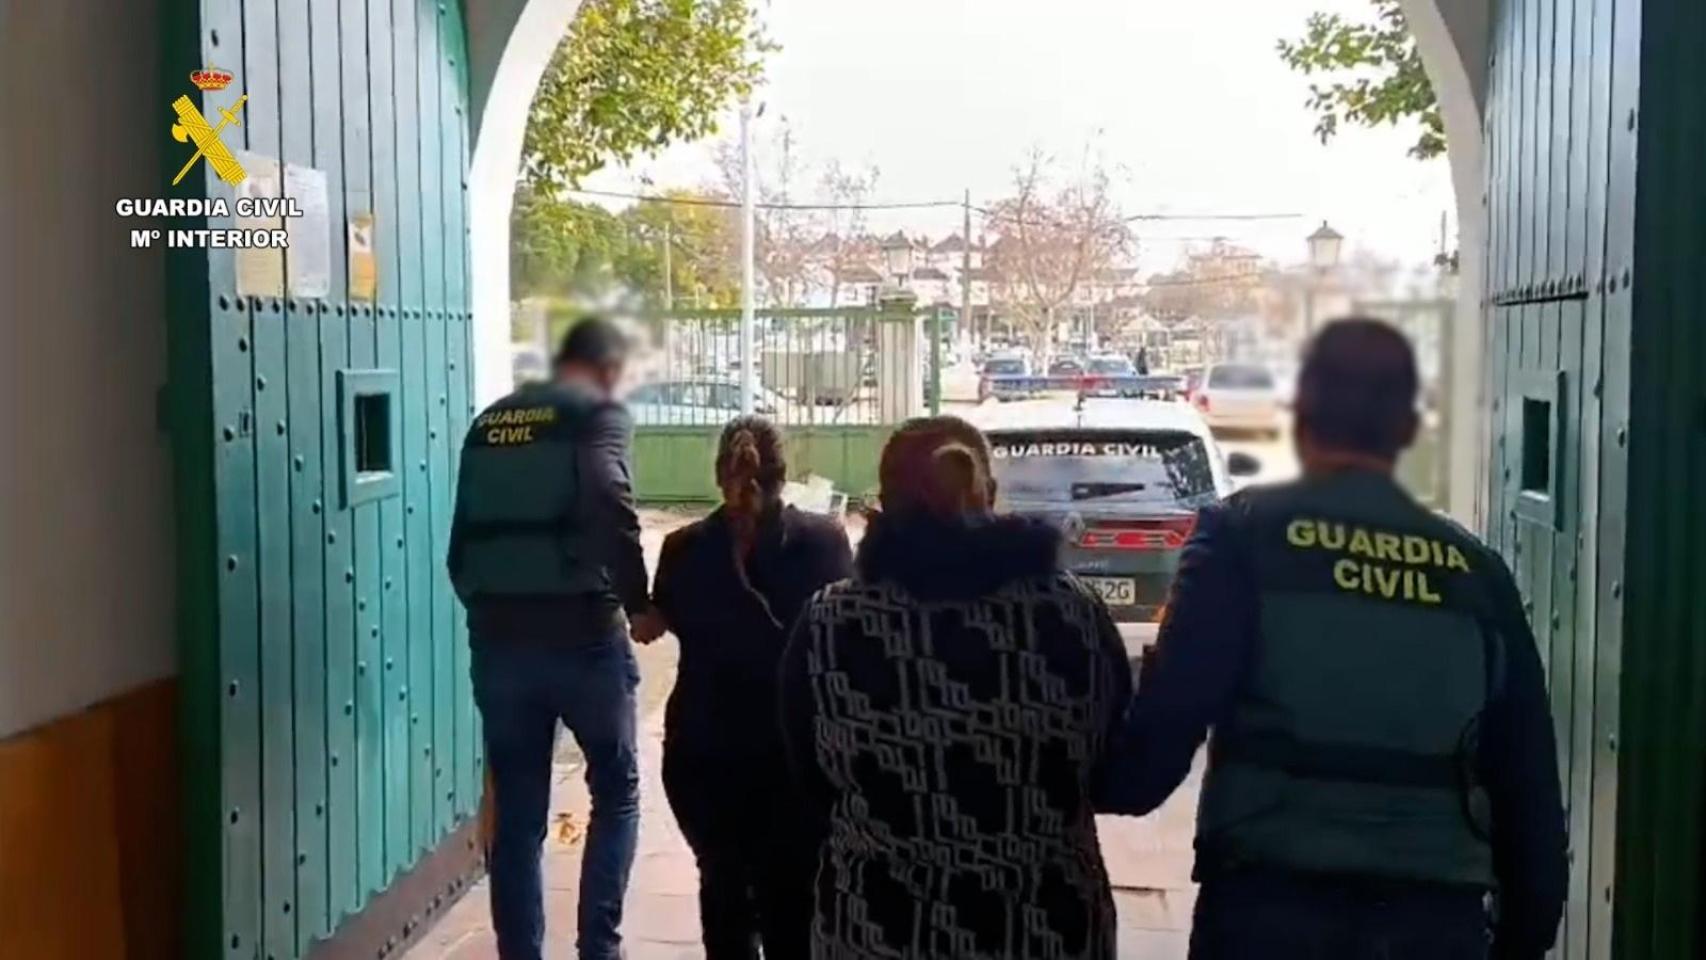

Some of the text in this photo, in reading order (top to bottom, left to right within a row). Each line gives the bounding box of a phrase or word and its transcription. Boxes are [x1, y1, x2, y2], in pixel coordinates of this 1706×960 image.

[477, 406, 556, 427] GUARDIA
[486, 425, 535, 443] CIVIL
[993, 442, 1163, 459] GUARDIA CIVIL
[1286, 518, 1470, 573] GUARDIA
[1333, 558, 1442, 603] CIVIL
